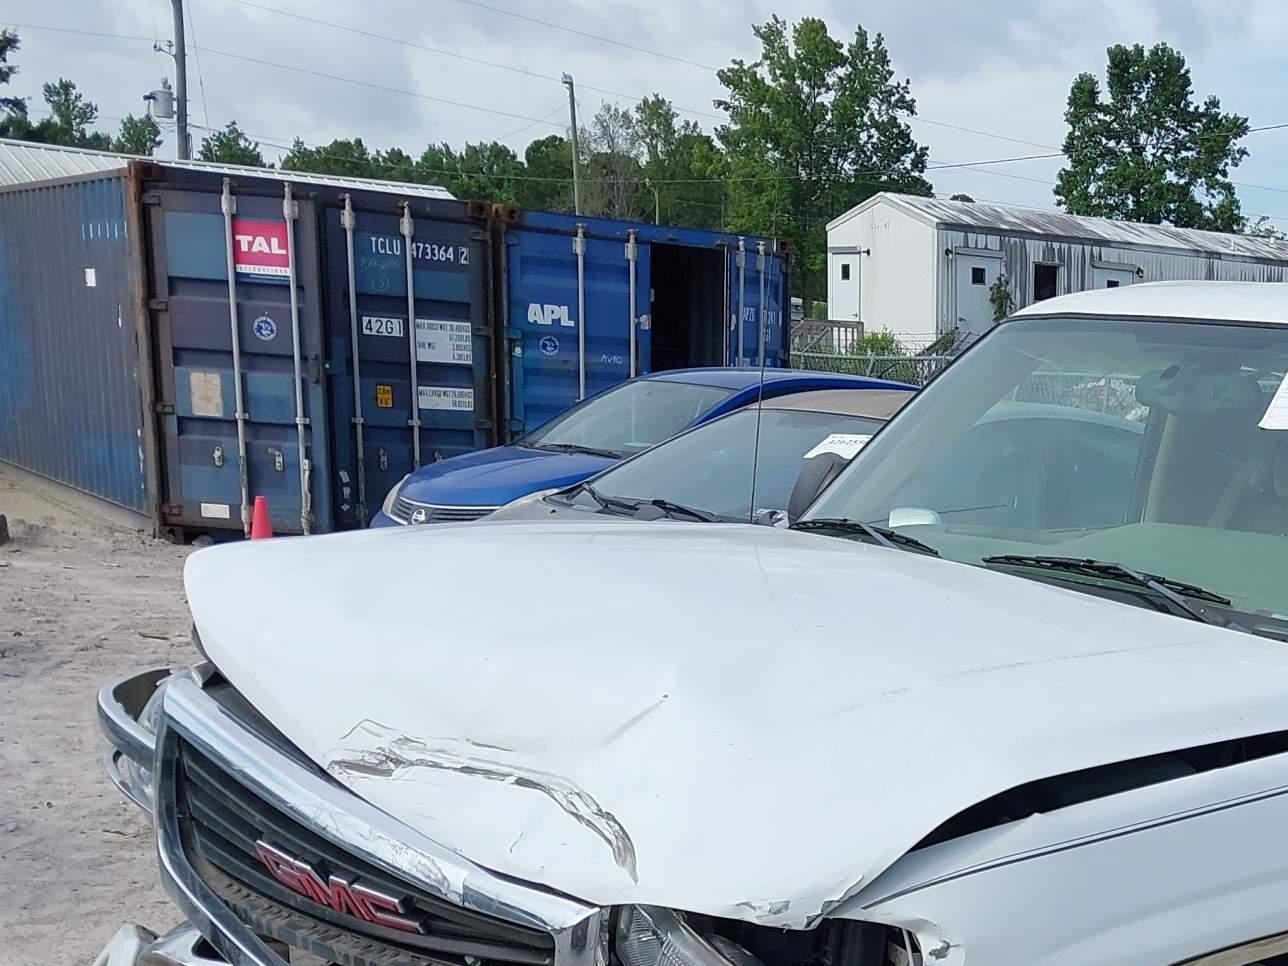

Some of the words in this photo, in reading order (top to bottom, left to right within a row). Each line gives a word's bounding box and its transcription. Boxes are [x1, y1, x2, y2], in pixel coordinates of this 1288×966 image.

[235, 234, 287, 255] TAL
[370, 237, 401, 255] TCLU
[527, 302, 575, 327] APL
[365, 318, 402, 335] 42G1
[255, 839, 427, 935] GMC
